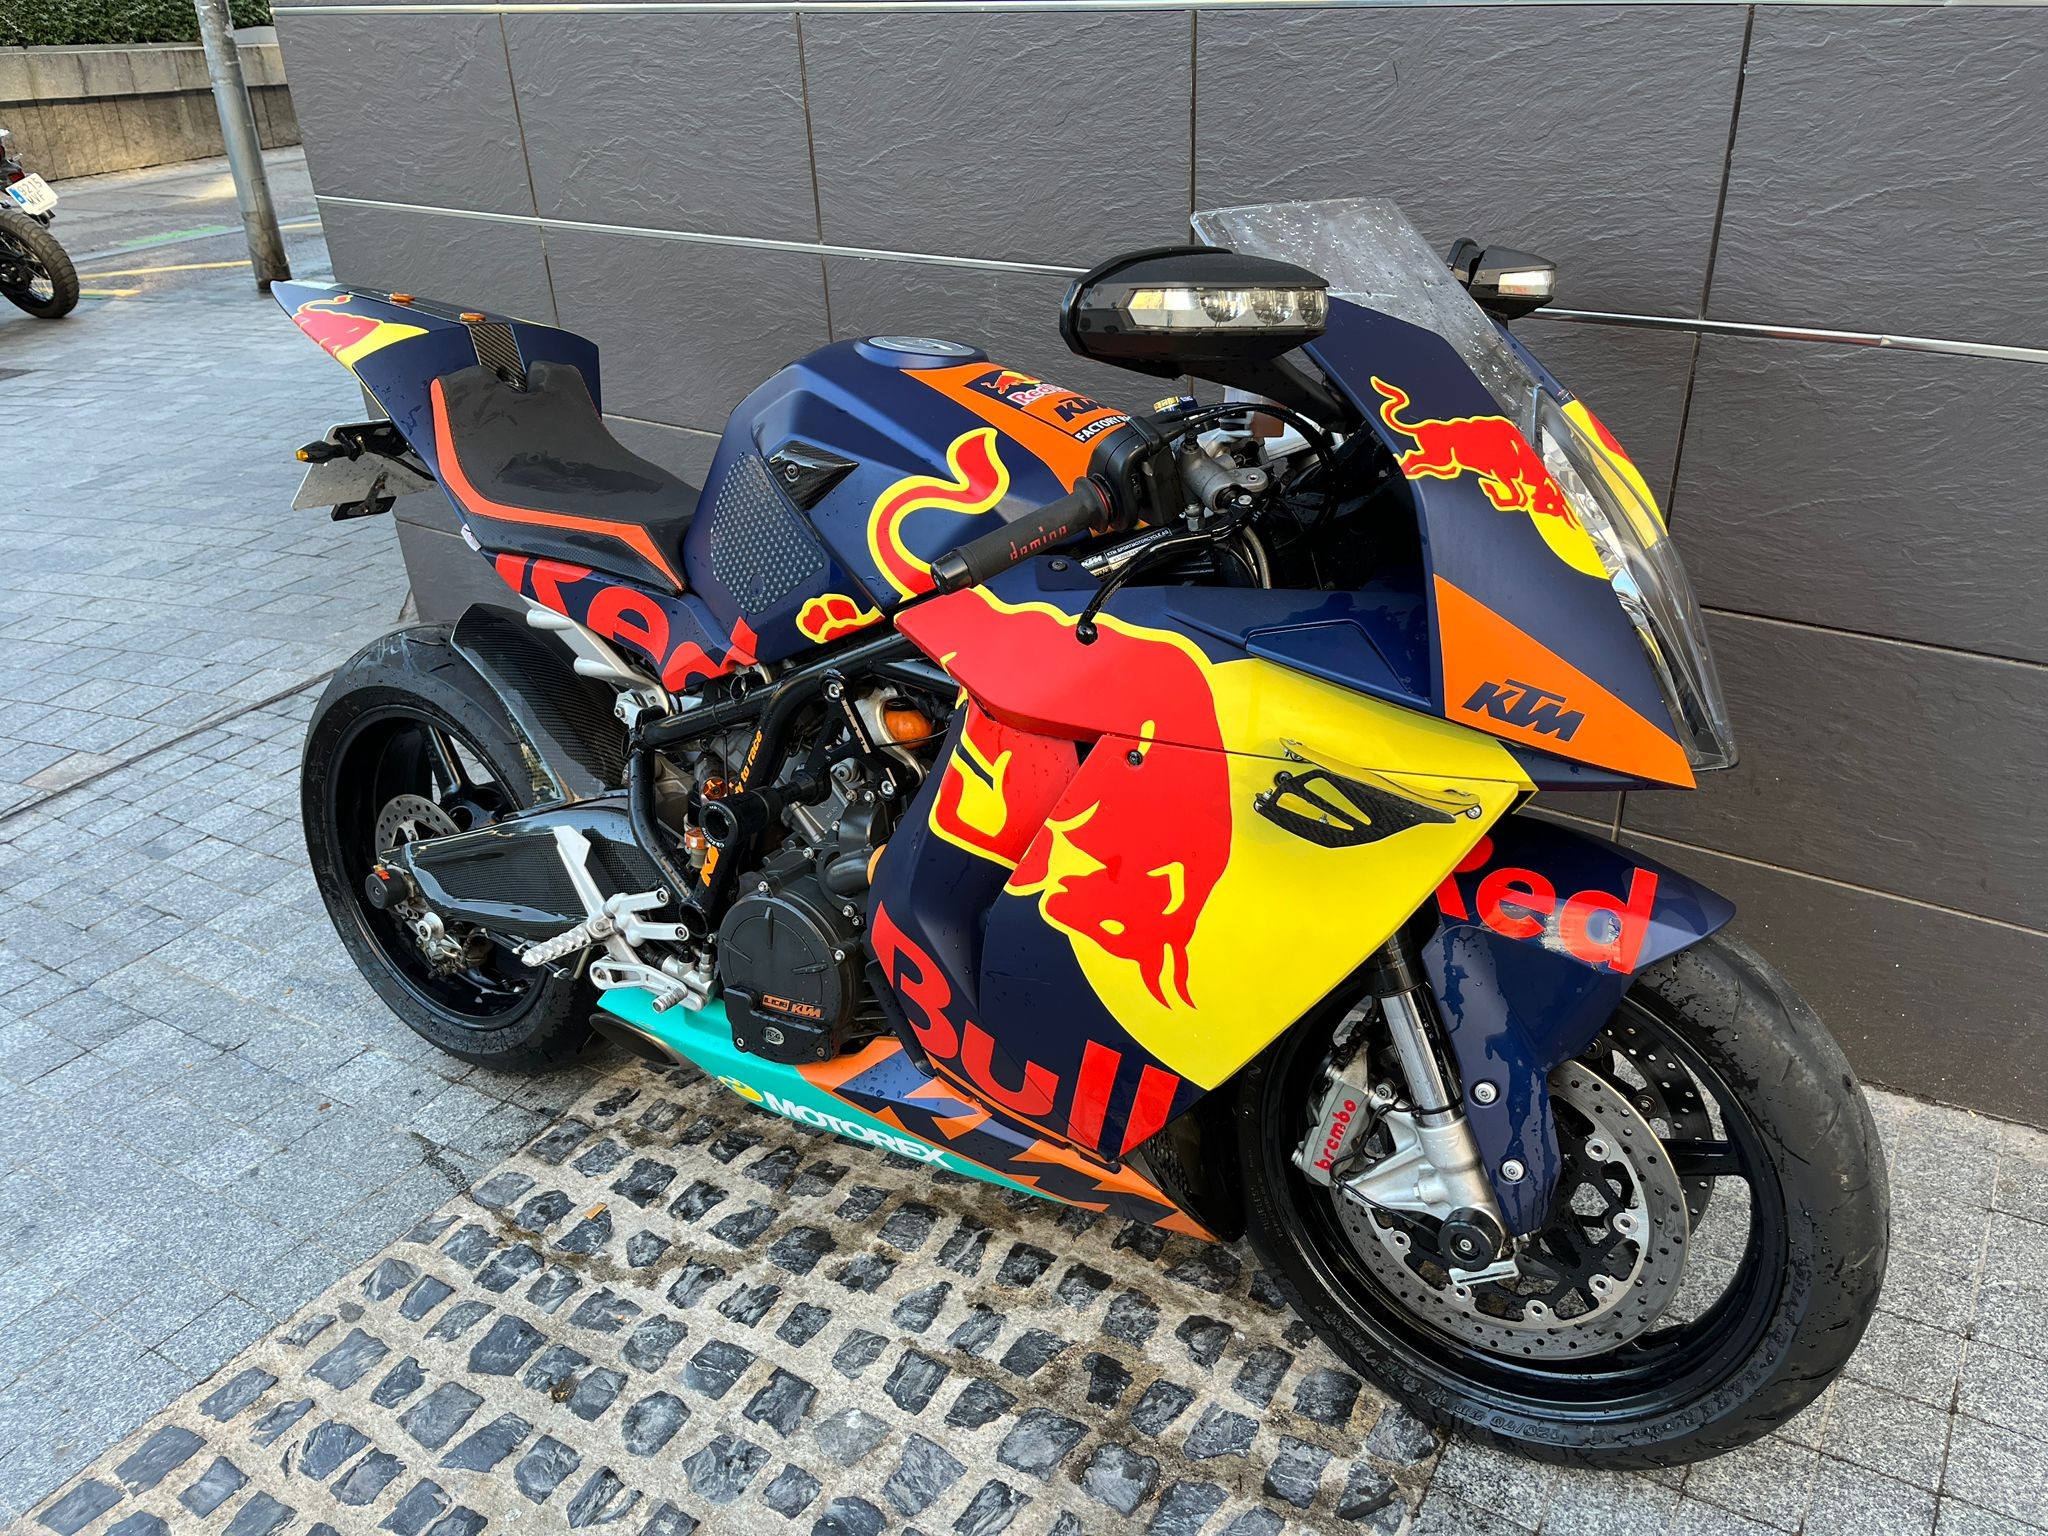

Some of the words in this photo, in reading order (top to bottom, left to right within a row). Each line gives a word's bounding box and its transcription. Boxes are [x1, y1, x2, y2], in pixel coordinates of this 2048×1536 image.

[17, 177, 43, 196] 9215
[1074, 415, 1121, 441] FACTORY
[1010, 525, 1067, 560] domino
[1461, 678, 1586, 742] KTM
[740, 765, 750, 783] to
[747, 729, 763, 767] race
[791, 1003, 822, 1018] KTM
[871, 900, 1180, 1157] Bull
[763, 1090, 954, 1169] MOTOREX
[1314, 1099, 1357, 1171] brembo
